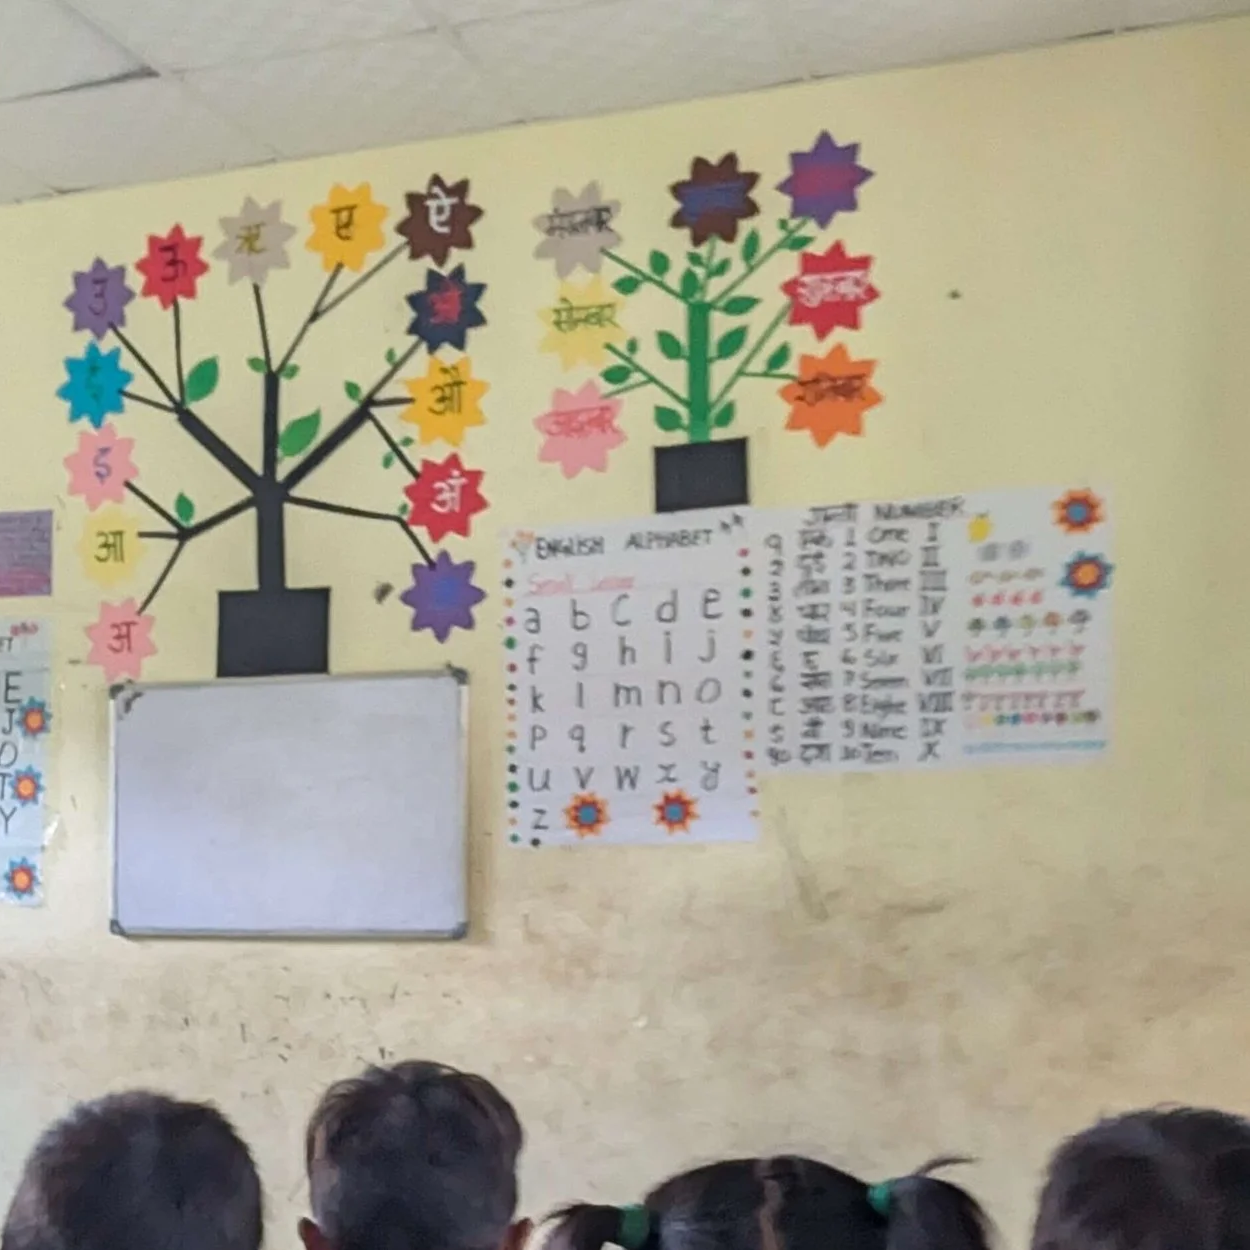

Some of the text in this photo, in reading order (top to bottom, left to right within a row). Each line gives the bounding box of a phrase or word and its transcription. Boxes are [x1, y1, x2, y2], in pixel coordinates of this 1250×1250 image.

[330, 204, 358, 241] ए
[95, 530, 127, 563] आ
[536, 529, 714, 560] ENGLISH ALPHABET
[526, 607, 541, 634] a
[571, 599, 590, 631] b
[656, 589, 678, 623] d
[702, 588, 722, 619] e
[863, 598, 910, 618] Four
[107, 622, 139, 653] अ
[527, 644, 543, 674] f
[572, 642, 587, 671] g
[619, 636, 636, 666] h
[698, 629, 716, 663] j
[4, 671, 25, 707] E
[531, 686, 544, 712] k
[614, 683, 642, 707] m
[658, 680, 681, 705] n
[2, 710, 14, 734] J
[530, 719, 714, 753] p q r s t
[528, 768, 550, 792] u
[701, 761, 721, 791] y
[532, 809, 549, 830] z
